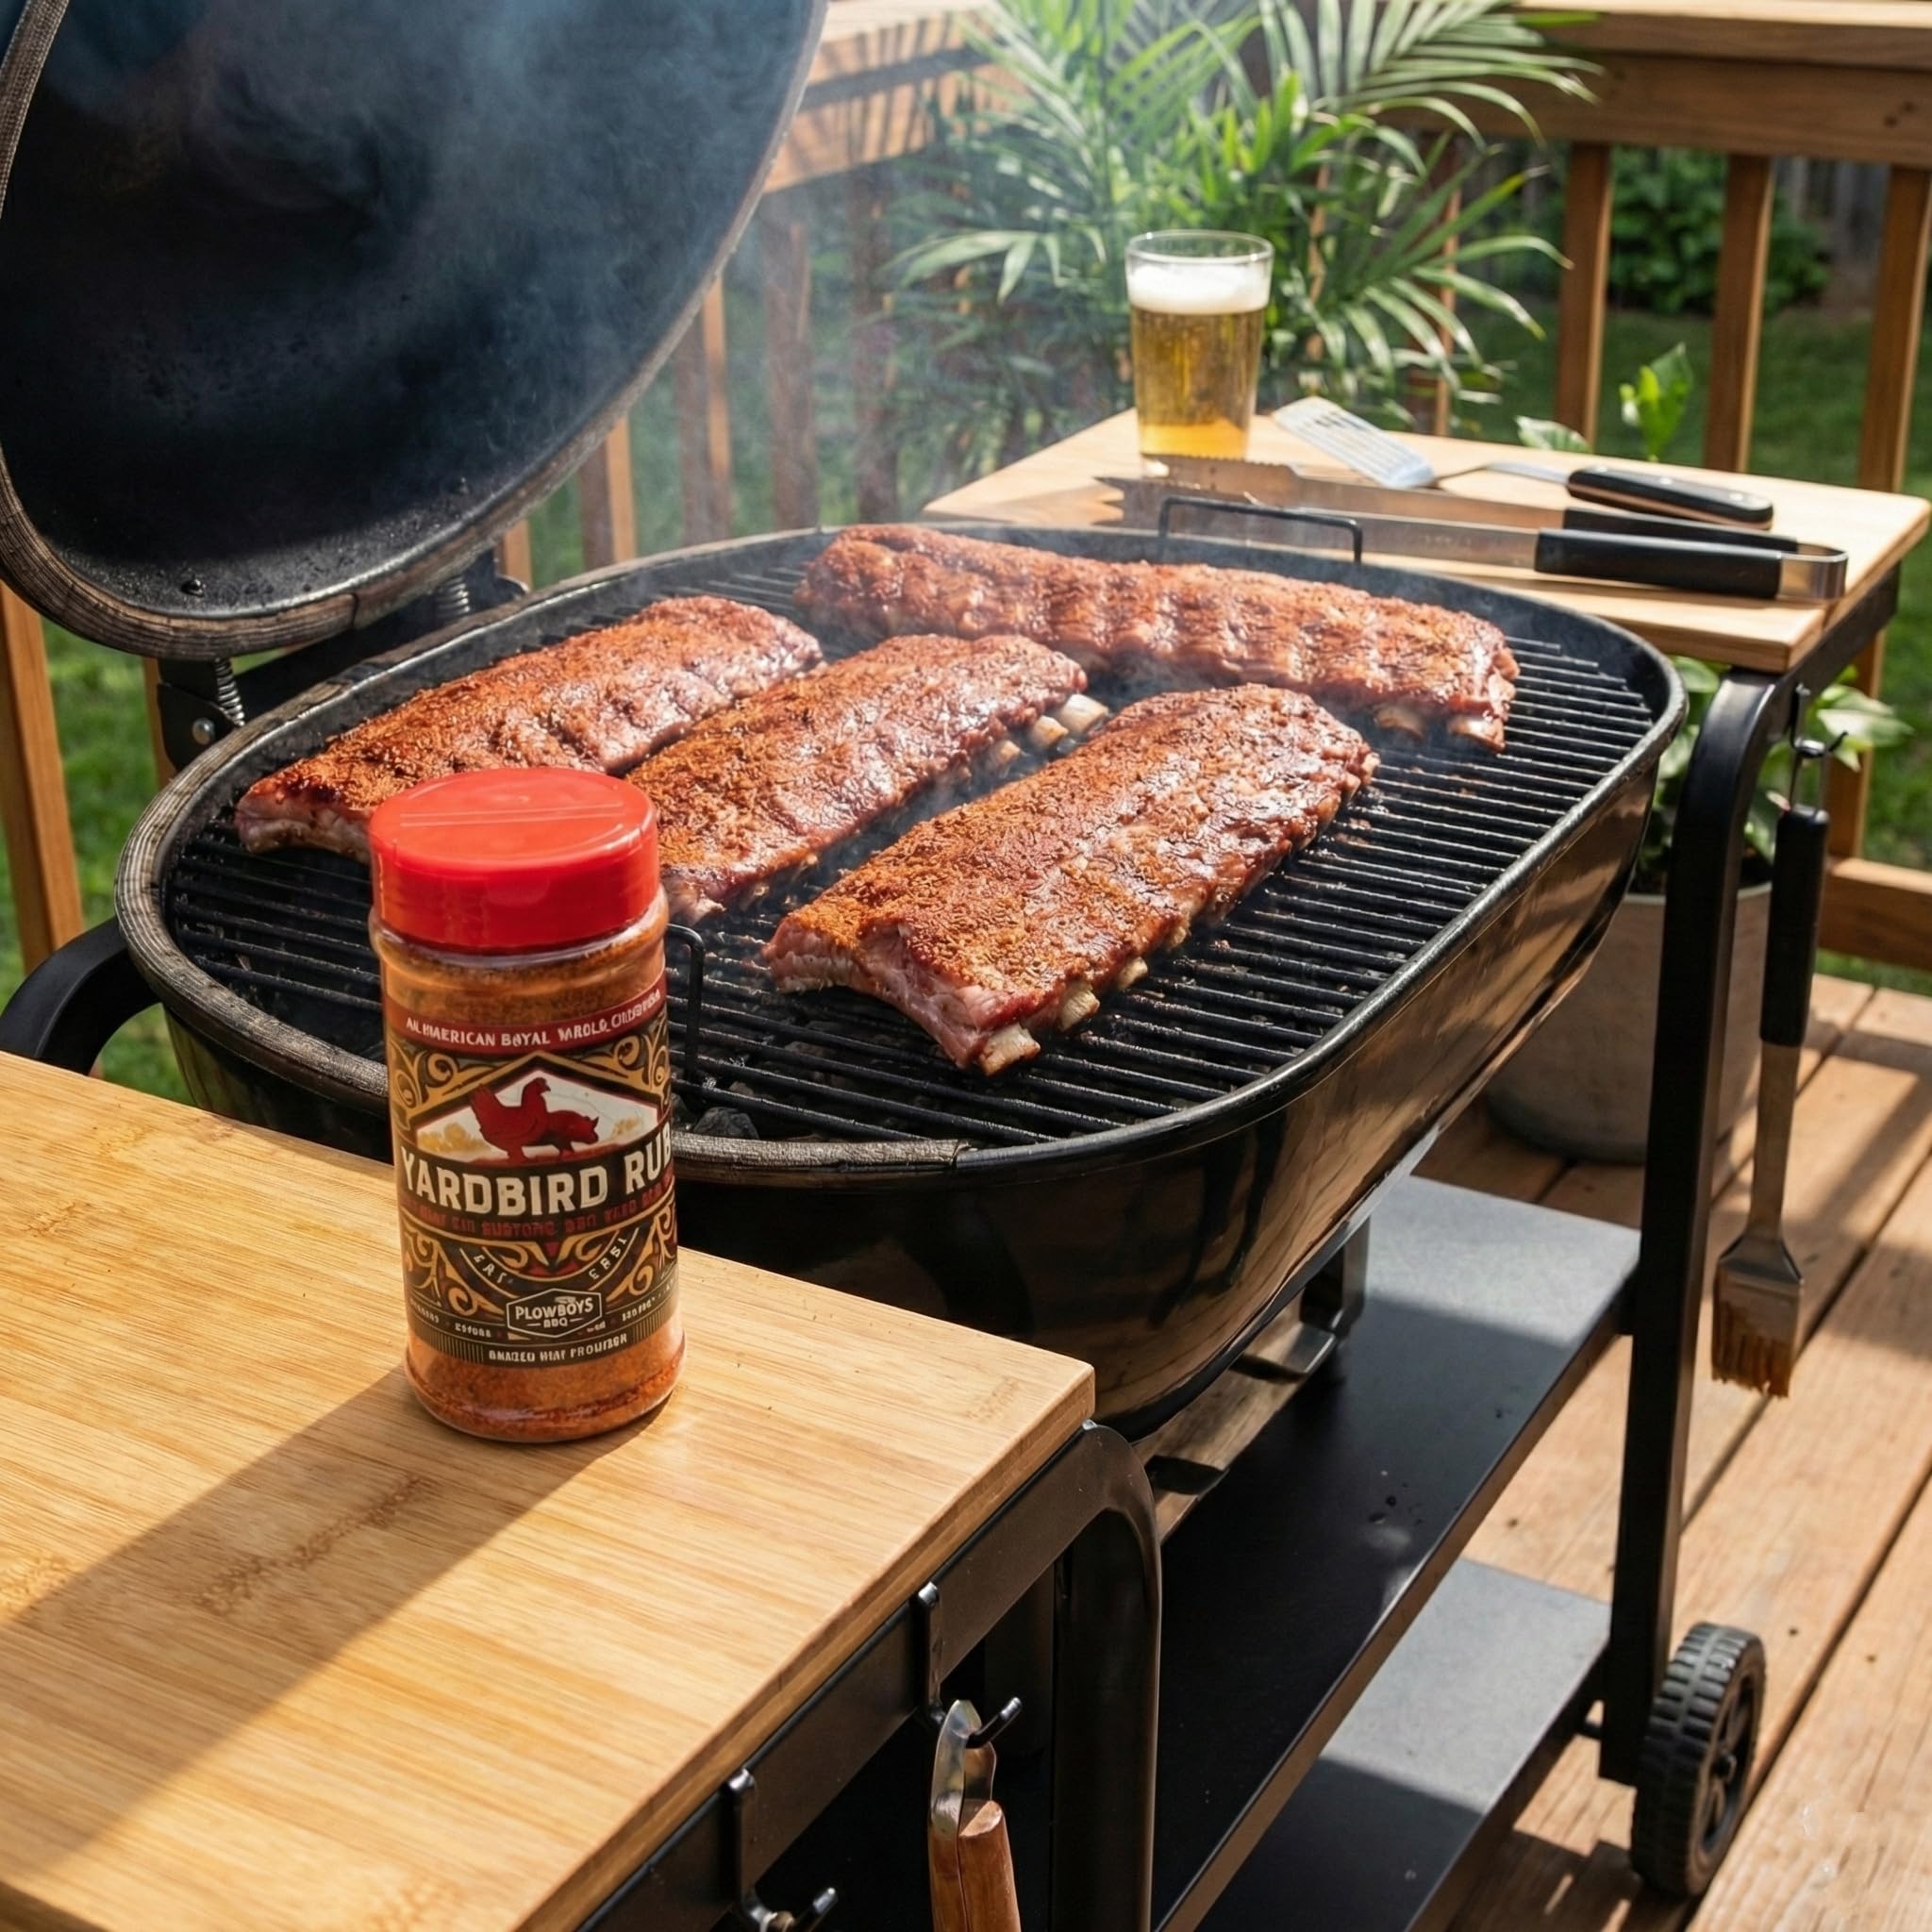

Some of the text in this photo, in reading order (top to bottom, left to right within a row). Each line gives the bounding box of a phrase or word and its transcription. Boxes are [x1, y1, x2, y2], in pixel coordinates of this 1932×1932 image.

[401, 1146, 608, 1217] YARDBIRD
[624, 1121, 672, 1195] RUB
[514, 1296, 594, 1321] PLOWBOYS
